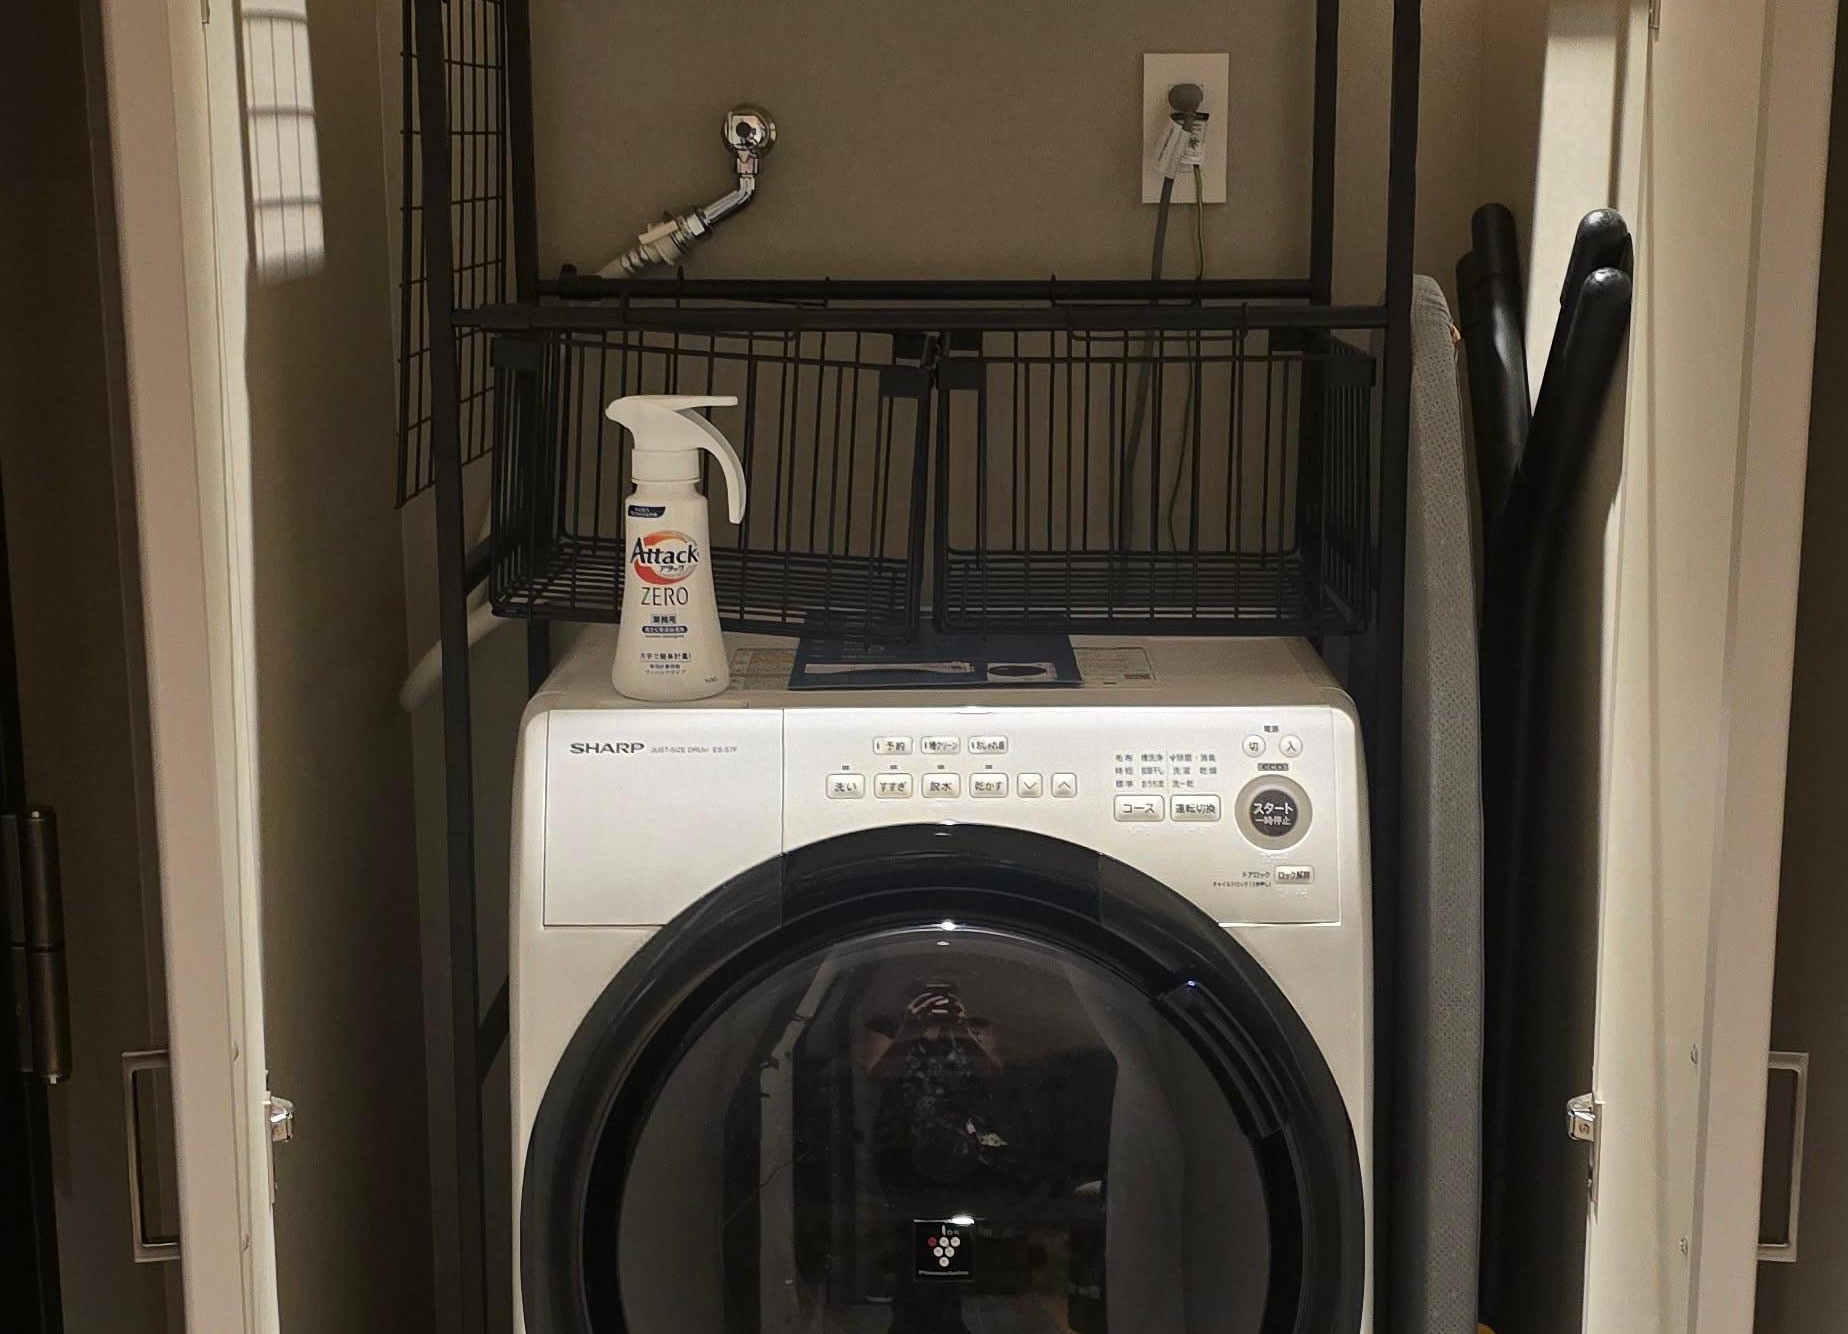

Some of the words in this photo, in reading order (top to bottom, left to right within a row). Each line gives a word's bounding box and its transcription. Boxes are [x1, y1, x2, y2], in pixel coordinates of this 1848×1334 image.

[630, 537, 699, 564] Attack
[641, 587, 689, 605] ZERO
[570, 742, 645, 754] SHARP
[1249, 741, 1259, 752] 切
[1287, 741, 1296, 752] 入
[834, 782, 857, 792] 洗い
[879, 782, 906, 792] すすぎ
[975, 781, 1002, 792] 乾かす
[1122, 803, 1155, 814] コース
[1175, 803, 1216, 814] 運転切換
[1253, 802, 1293, 815] スタート
[1255, 815, 1292, 826] 一時停止
